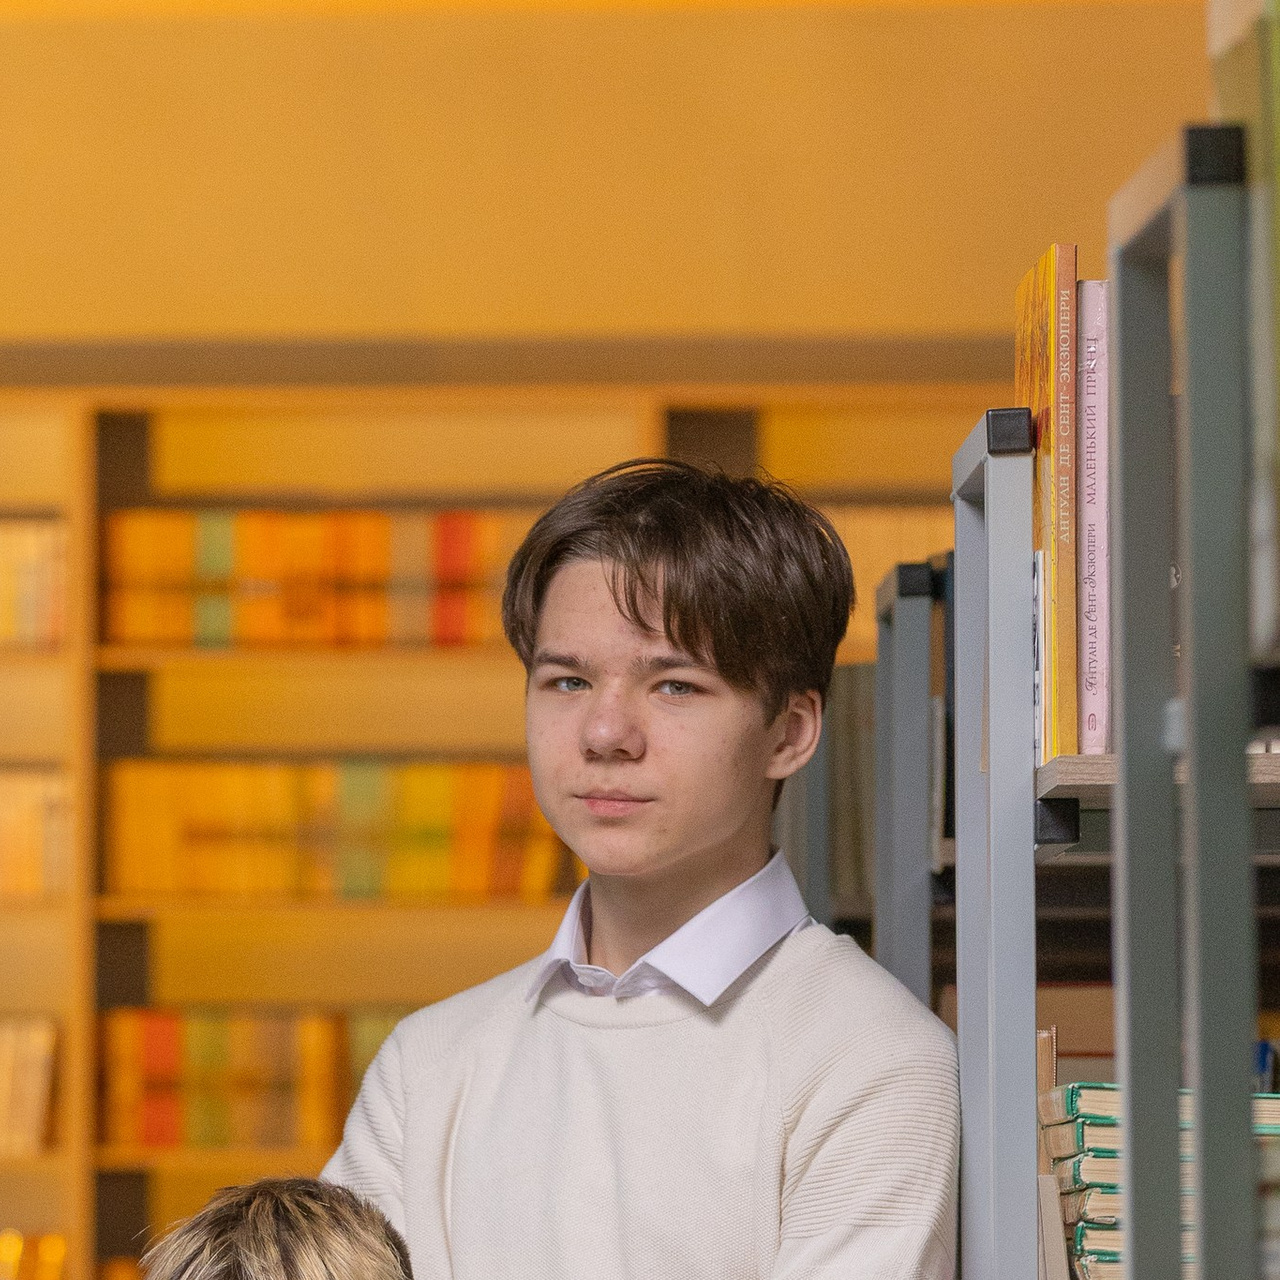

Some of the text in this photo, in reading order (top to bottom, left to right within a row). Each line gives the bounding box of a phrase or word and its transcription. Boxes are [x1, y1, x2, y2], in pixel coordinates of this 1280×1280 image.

[1059, 289, 1071, 544] АНТУАН ДЕ СЕНТ-ЭКЗЮПЕРИ
[1084, 405, 1097, 506] МАЛЕНЬКИЙ
